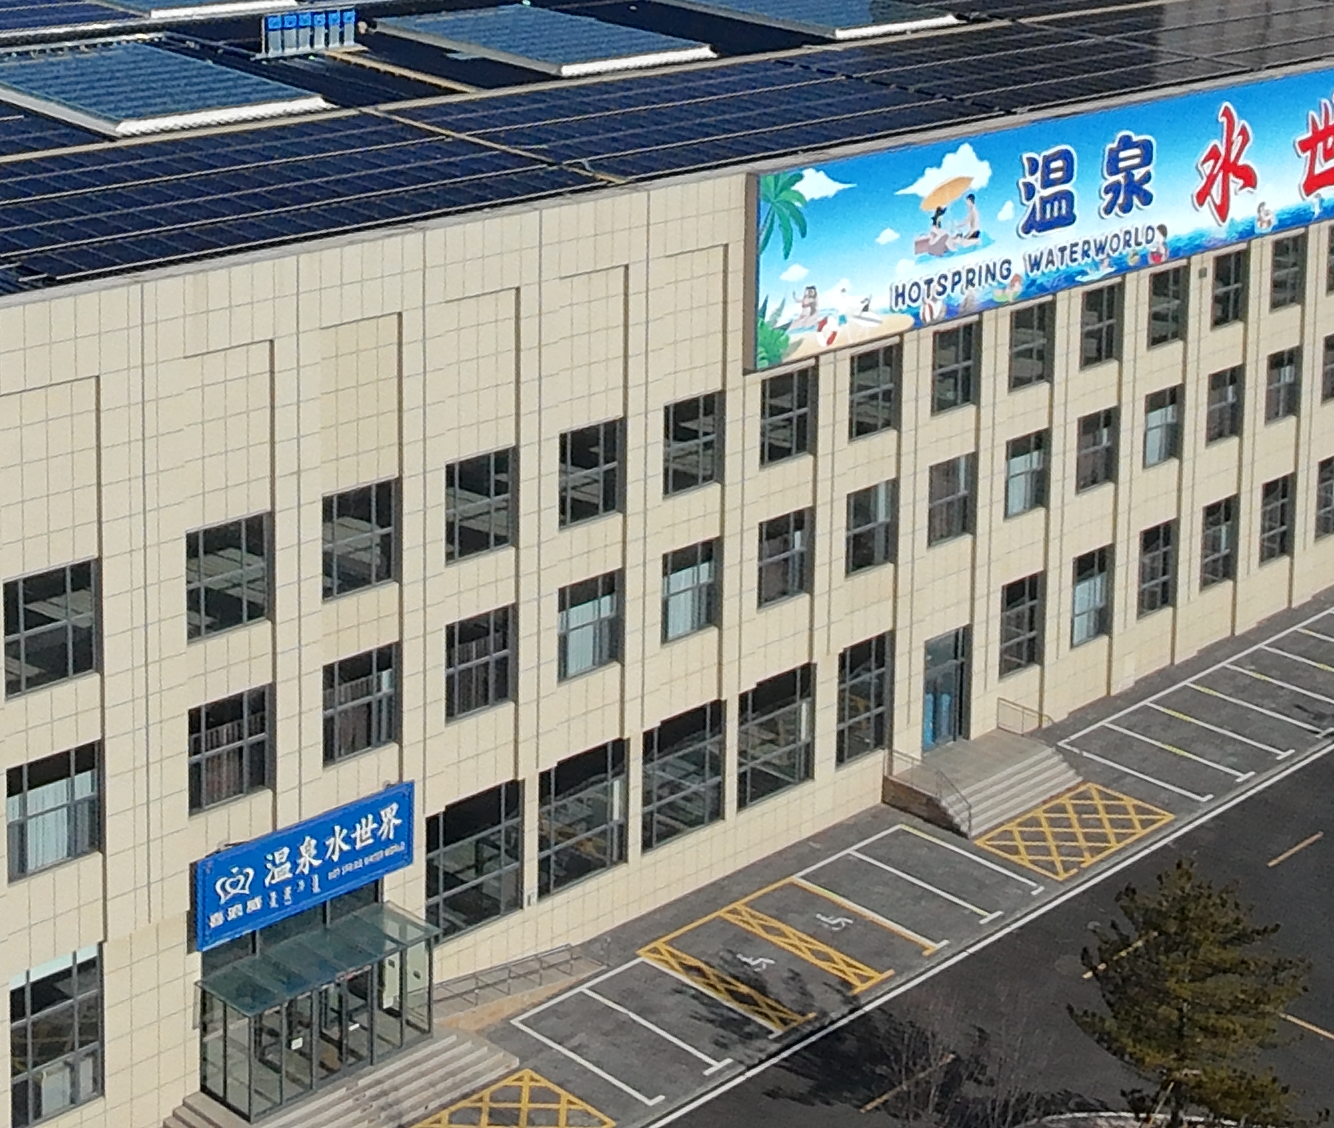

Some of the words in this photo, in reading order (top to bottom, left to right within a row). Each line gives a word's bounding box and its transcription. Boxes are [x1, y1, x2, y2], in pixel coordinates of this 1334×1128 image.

[893, 258, 1013, 309] HOTSPRING
[1026, 225, 1156, 273] WATERWORLD
[264, 802, 403, 887] 温泉水世界
